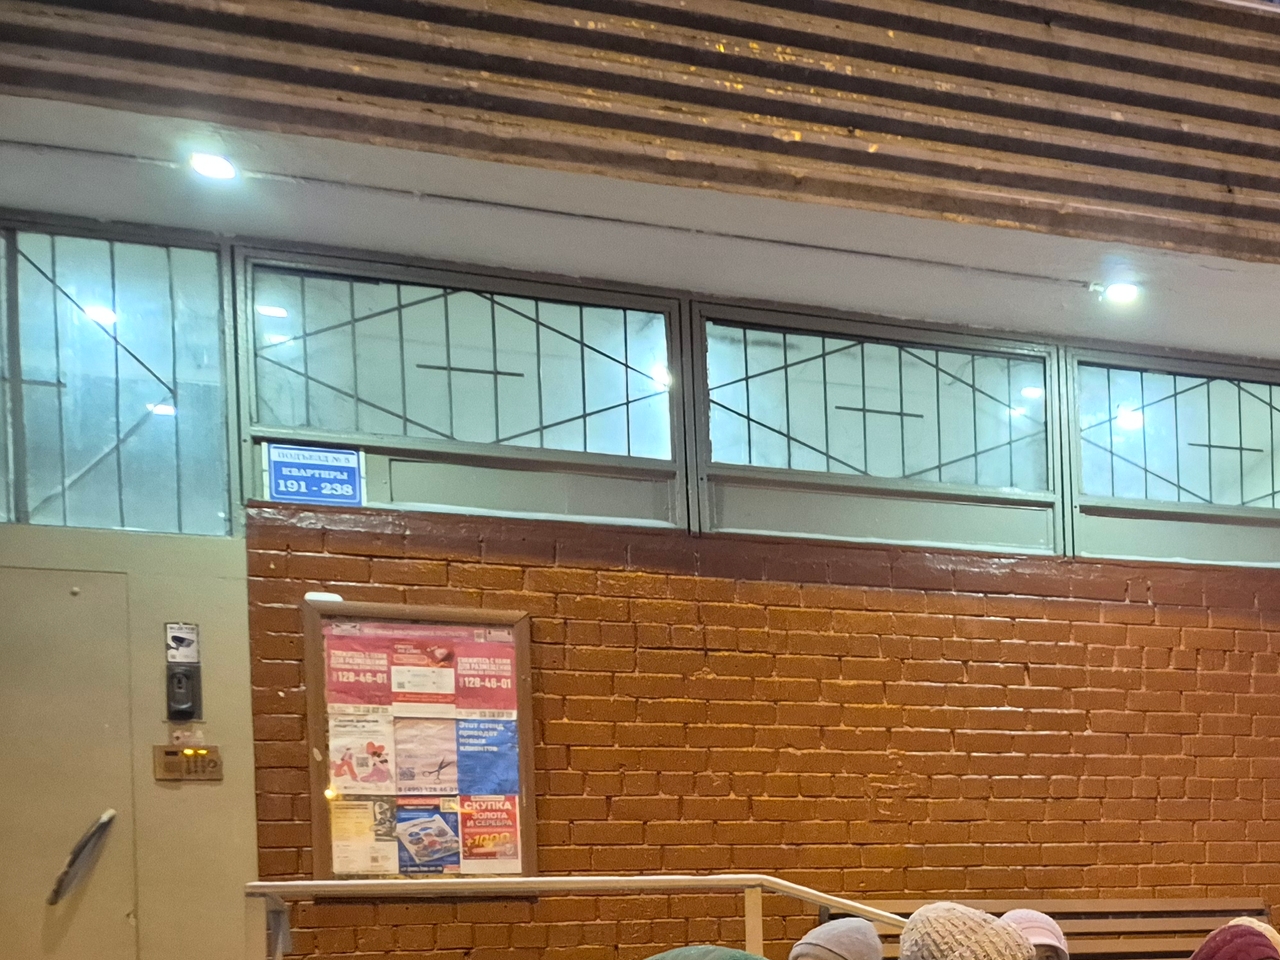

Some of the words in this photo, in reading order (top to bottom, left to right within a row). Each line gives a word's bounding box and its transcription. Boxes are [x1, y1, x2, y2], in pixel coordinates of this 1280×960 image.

[278, 452, 329, 463] ПОДЪЕЗД
[282, 467, 348, 480] КВАРТИРЫ
[278, 480, 308, 493] 191
[321, 482, 354, 496] 238
[338, 672, 388, 684] 128-46-01
[465, 677, 512, 689] 128-46-01
[464, 801, 513, 810] СКУПКА
[472, 812, 509, 820] ЗОЛОТА
[467, 819, 475, 827] И
[475, 819, 513, 827] СЕРЕБРА
